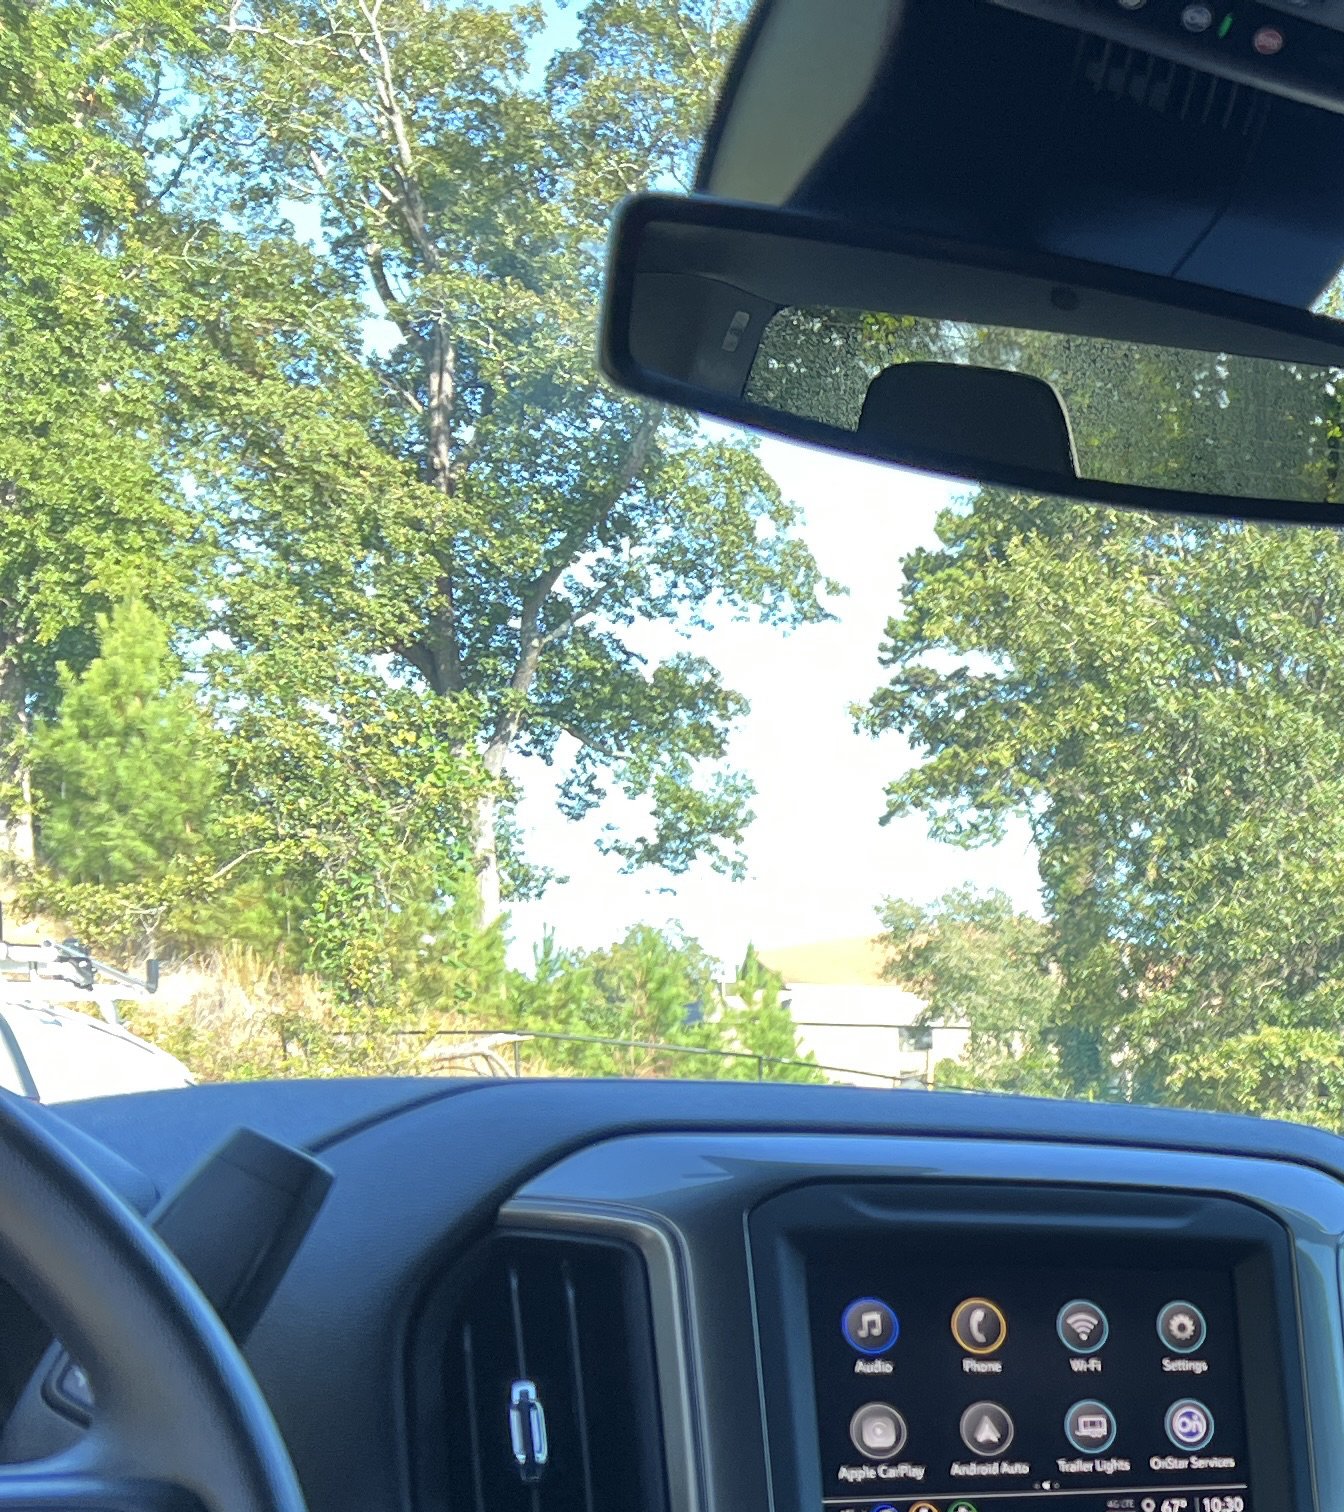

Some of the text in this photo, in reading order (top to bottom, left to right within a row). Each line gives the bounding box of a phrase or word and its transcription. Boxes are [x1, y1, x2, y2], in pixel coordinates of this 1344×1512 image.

[854, 1359, 895, 1374] Audio
[962, 1358, 1002, 1373] Phone
[1069, 1358, 1102, 1372] Wi-Fi
[1161, 1358, 1209, 1374] Settings
[950, 1461, 1030, 1477] Android Auto
[1056, 1457, 1131, 1474] Trailer Lights
[1150, 1455, 1236, 1471] OnStar Services
[838, 1463, 926, 1482] Apple CarPlay
[1202, 1495, 1244, 1512] 10:30
